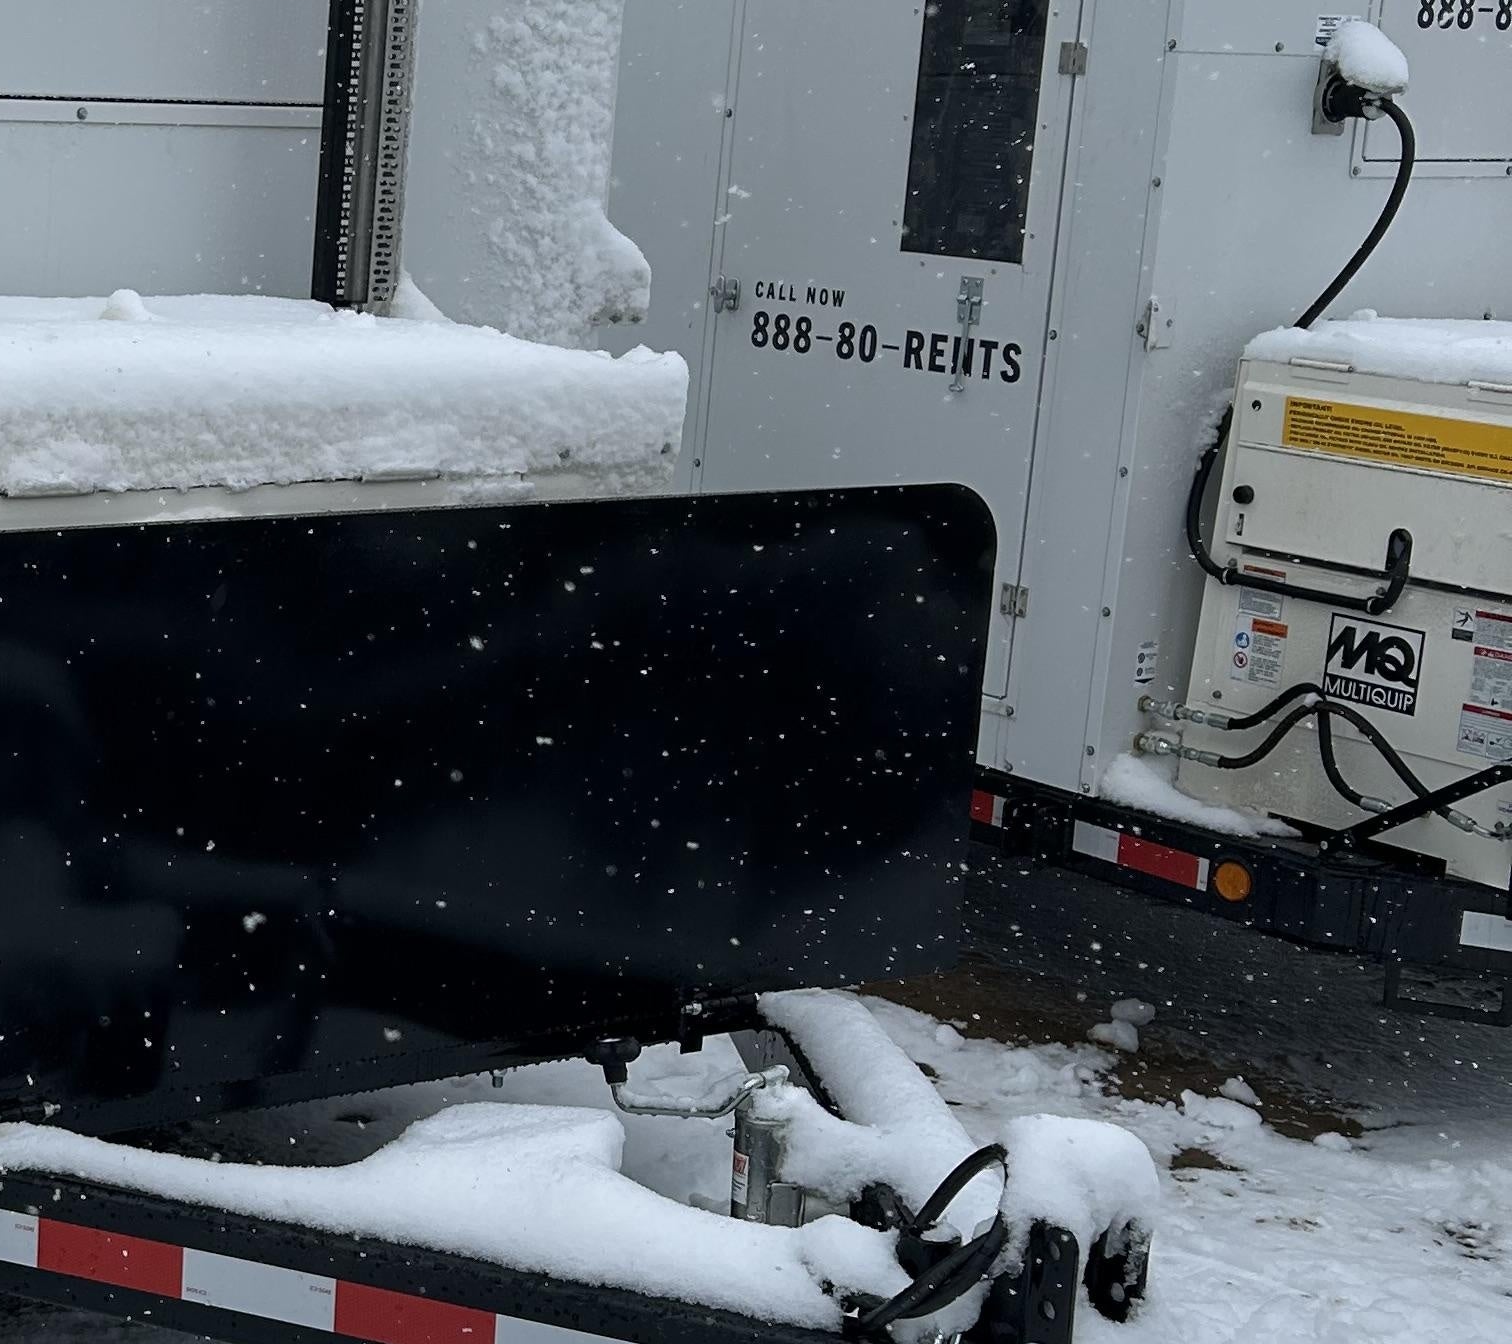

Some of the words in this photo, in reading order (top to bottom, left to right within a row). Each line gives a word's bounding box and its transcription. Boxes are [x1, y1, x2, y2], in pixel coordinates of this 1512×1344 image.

[755, 281, 797, 302] CALL
[806, 285, 845, 308] NOW
[1327, 625, 1418, 689] MQ
[1324, 676, 1414, 712] MULTIQUIP
